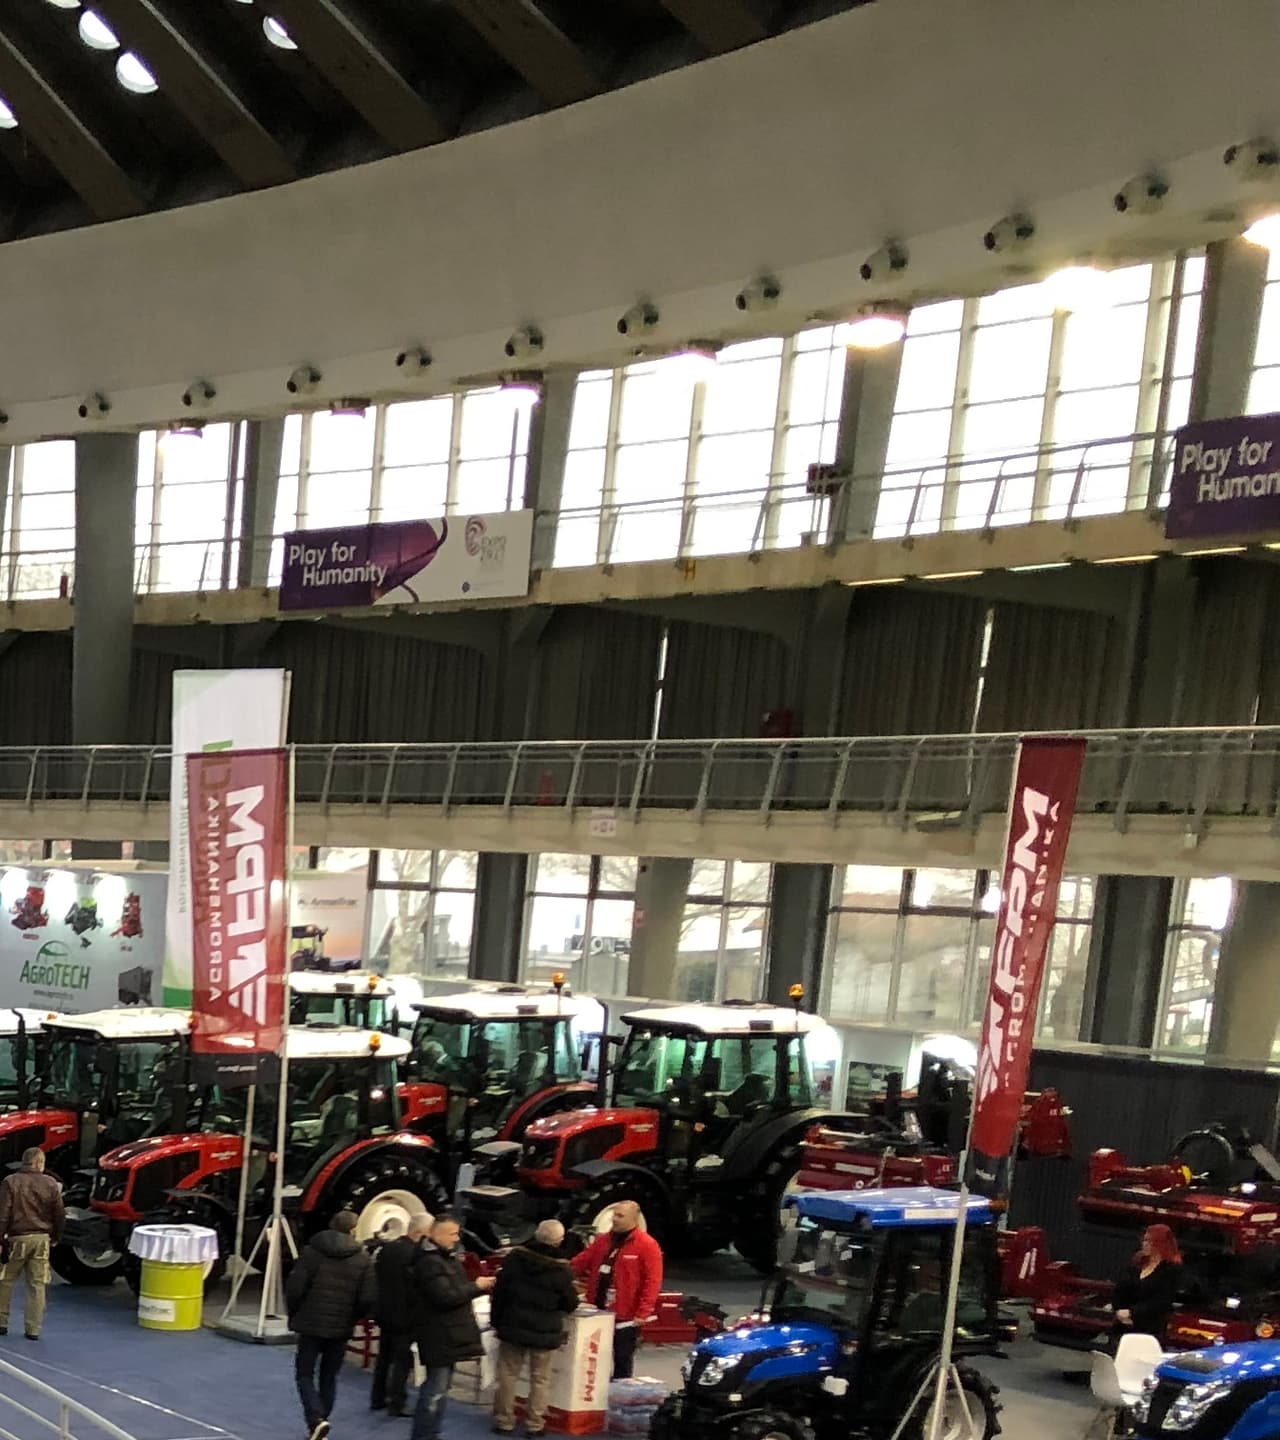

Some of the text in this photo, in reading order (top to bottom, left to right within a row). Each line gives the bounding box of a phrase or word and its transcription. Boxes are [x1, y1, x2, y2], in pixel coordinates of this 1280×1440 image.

[1181, 436, 1272, 476] Play for
[289, 541, 357, 567] Play for
[303, 561, 388, 587] Humanity
[19, 959, 91, 990] AGROTECH
